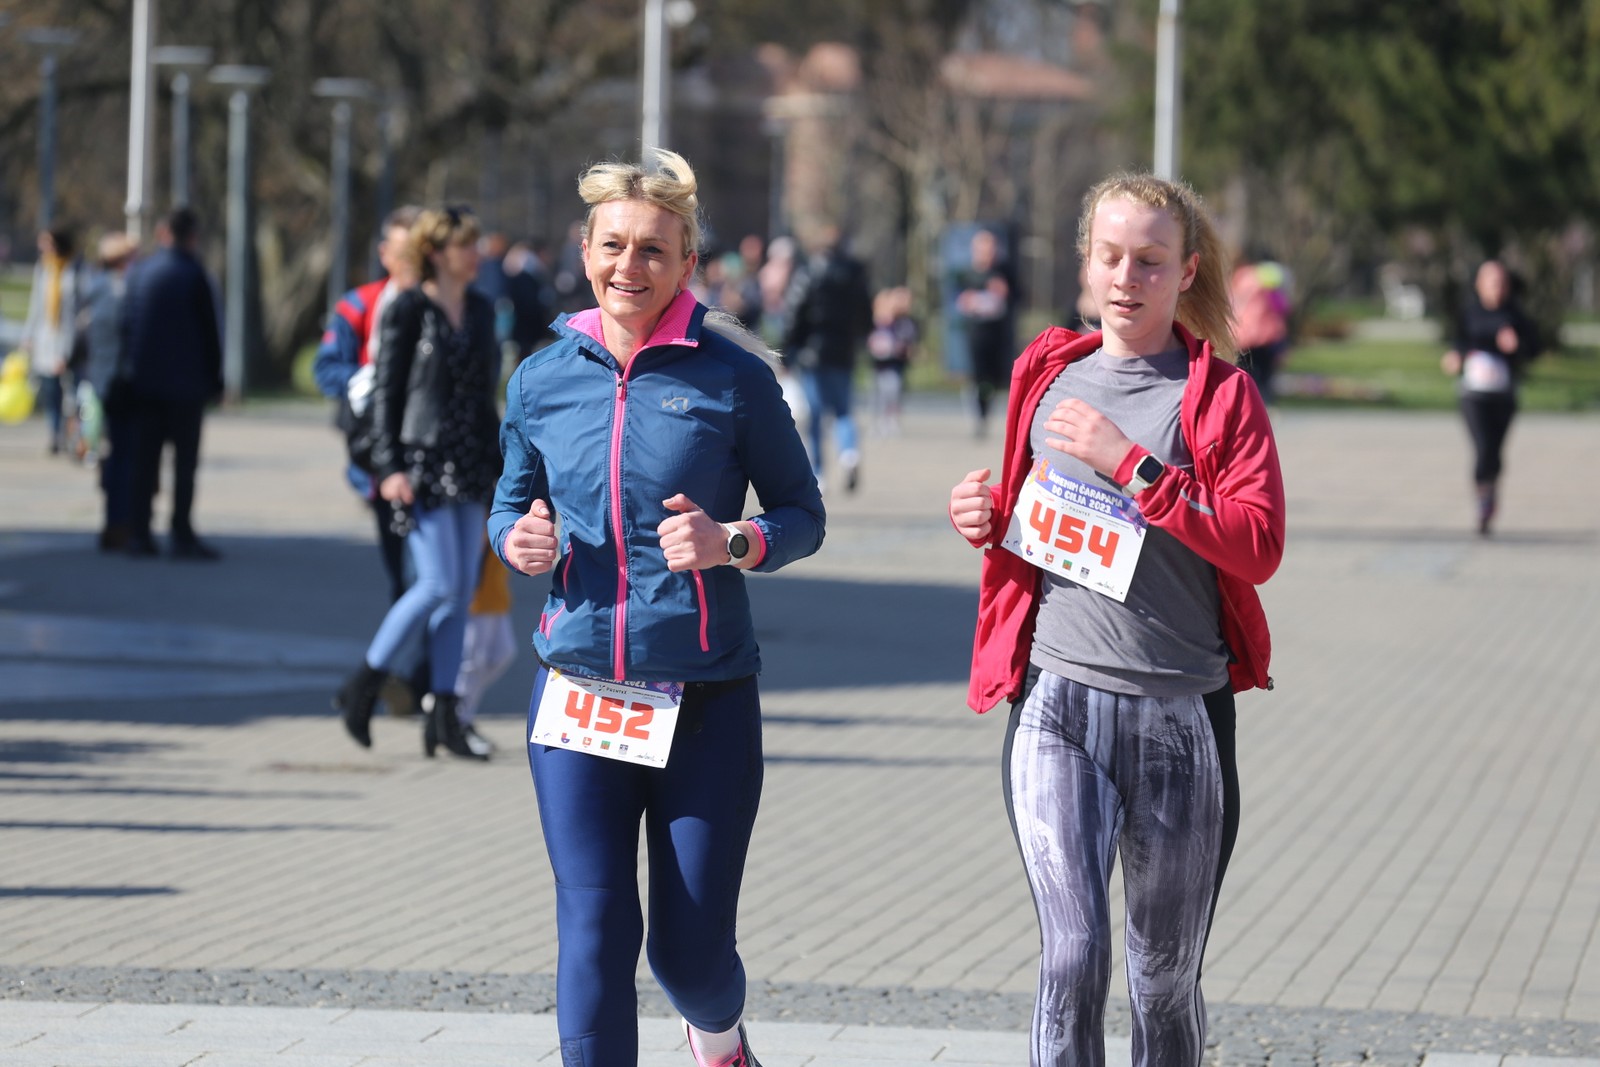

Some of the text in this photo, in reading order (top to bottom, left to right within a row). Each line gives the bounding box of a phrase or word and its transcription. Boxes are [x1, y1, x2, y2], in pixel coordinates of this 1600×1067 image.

[1051, 484, 1063, 497] DO
[1064, 490, 1087, 506] CILJA
[1079, 482, 1123, 508] ČARAPAMA
[1029, 500, 1120, 569] 454
[564, 690, 655, 740] 452
